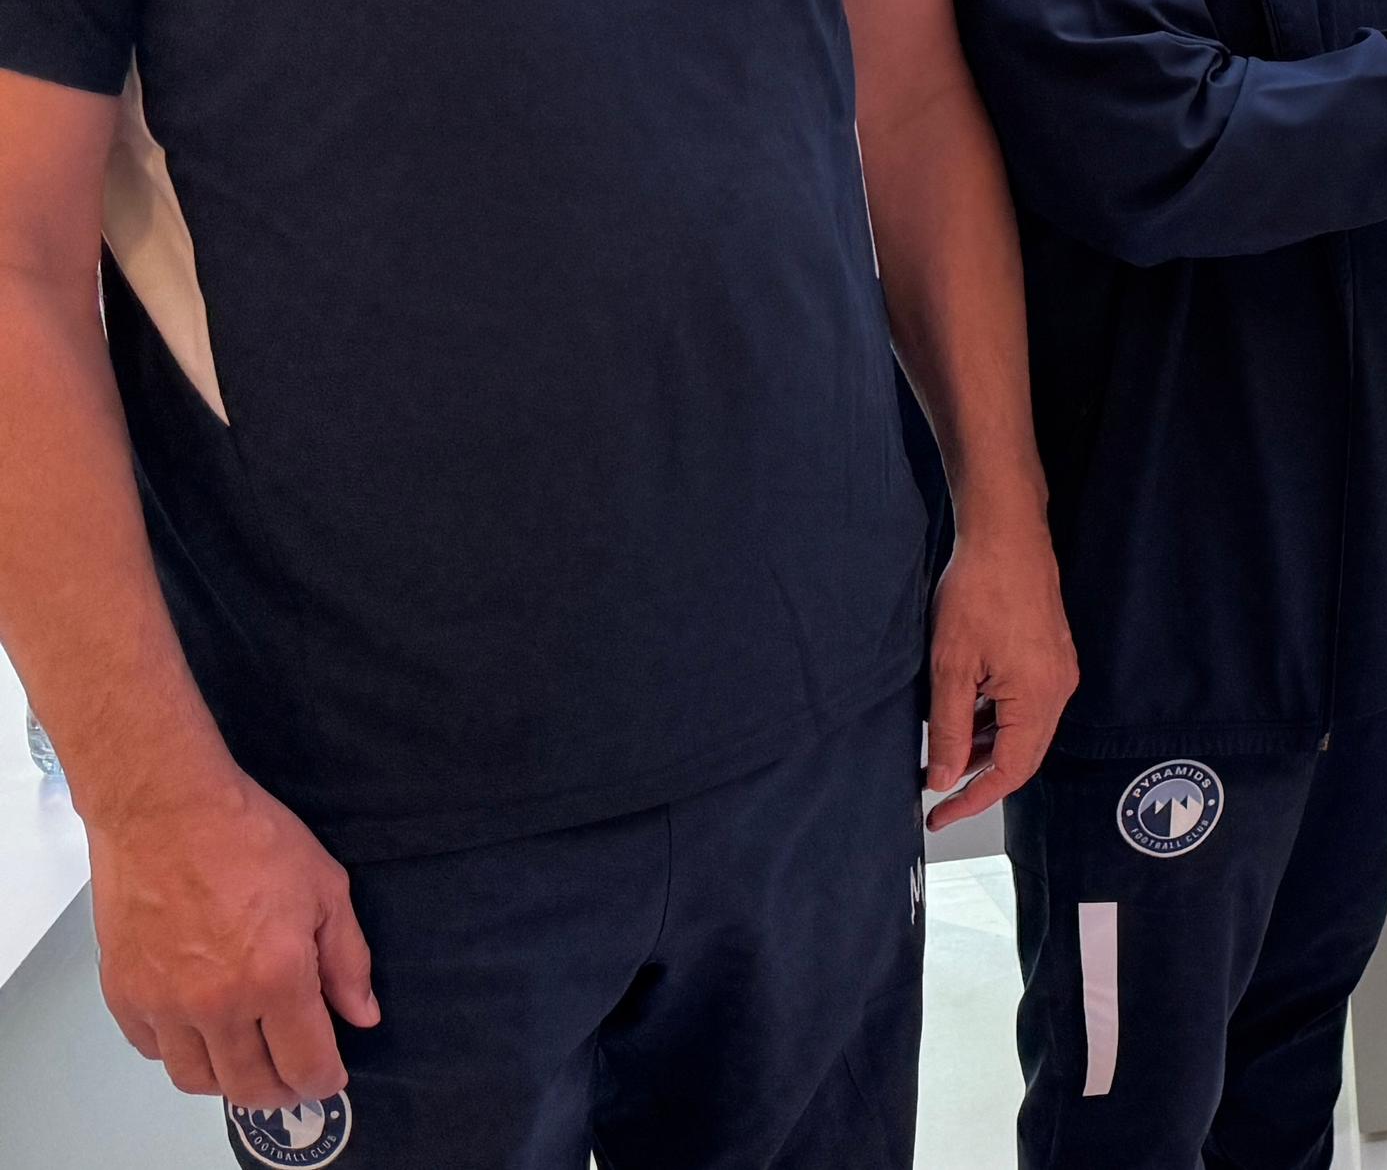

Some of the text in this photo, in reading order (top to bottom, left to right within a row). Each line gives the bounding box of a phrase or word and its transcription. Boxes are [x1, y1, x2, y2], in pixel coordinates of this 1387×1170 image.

[1132, 766, 1212, 798] PYRAMIDS
[1131, 819, 1209, 850] FOOTBALL CLUB
[249, 1130, 337, 1162] FOOTBALL CLUB
